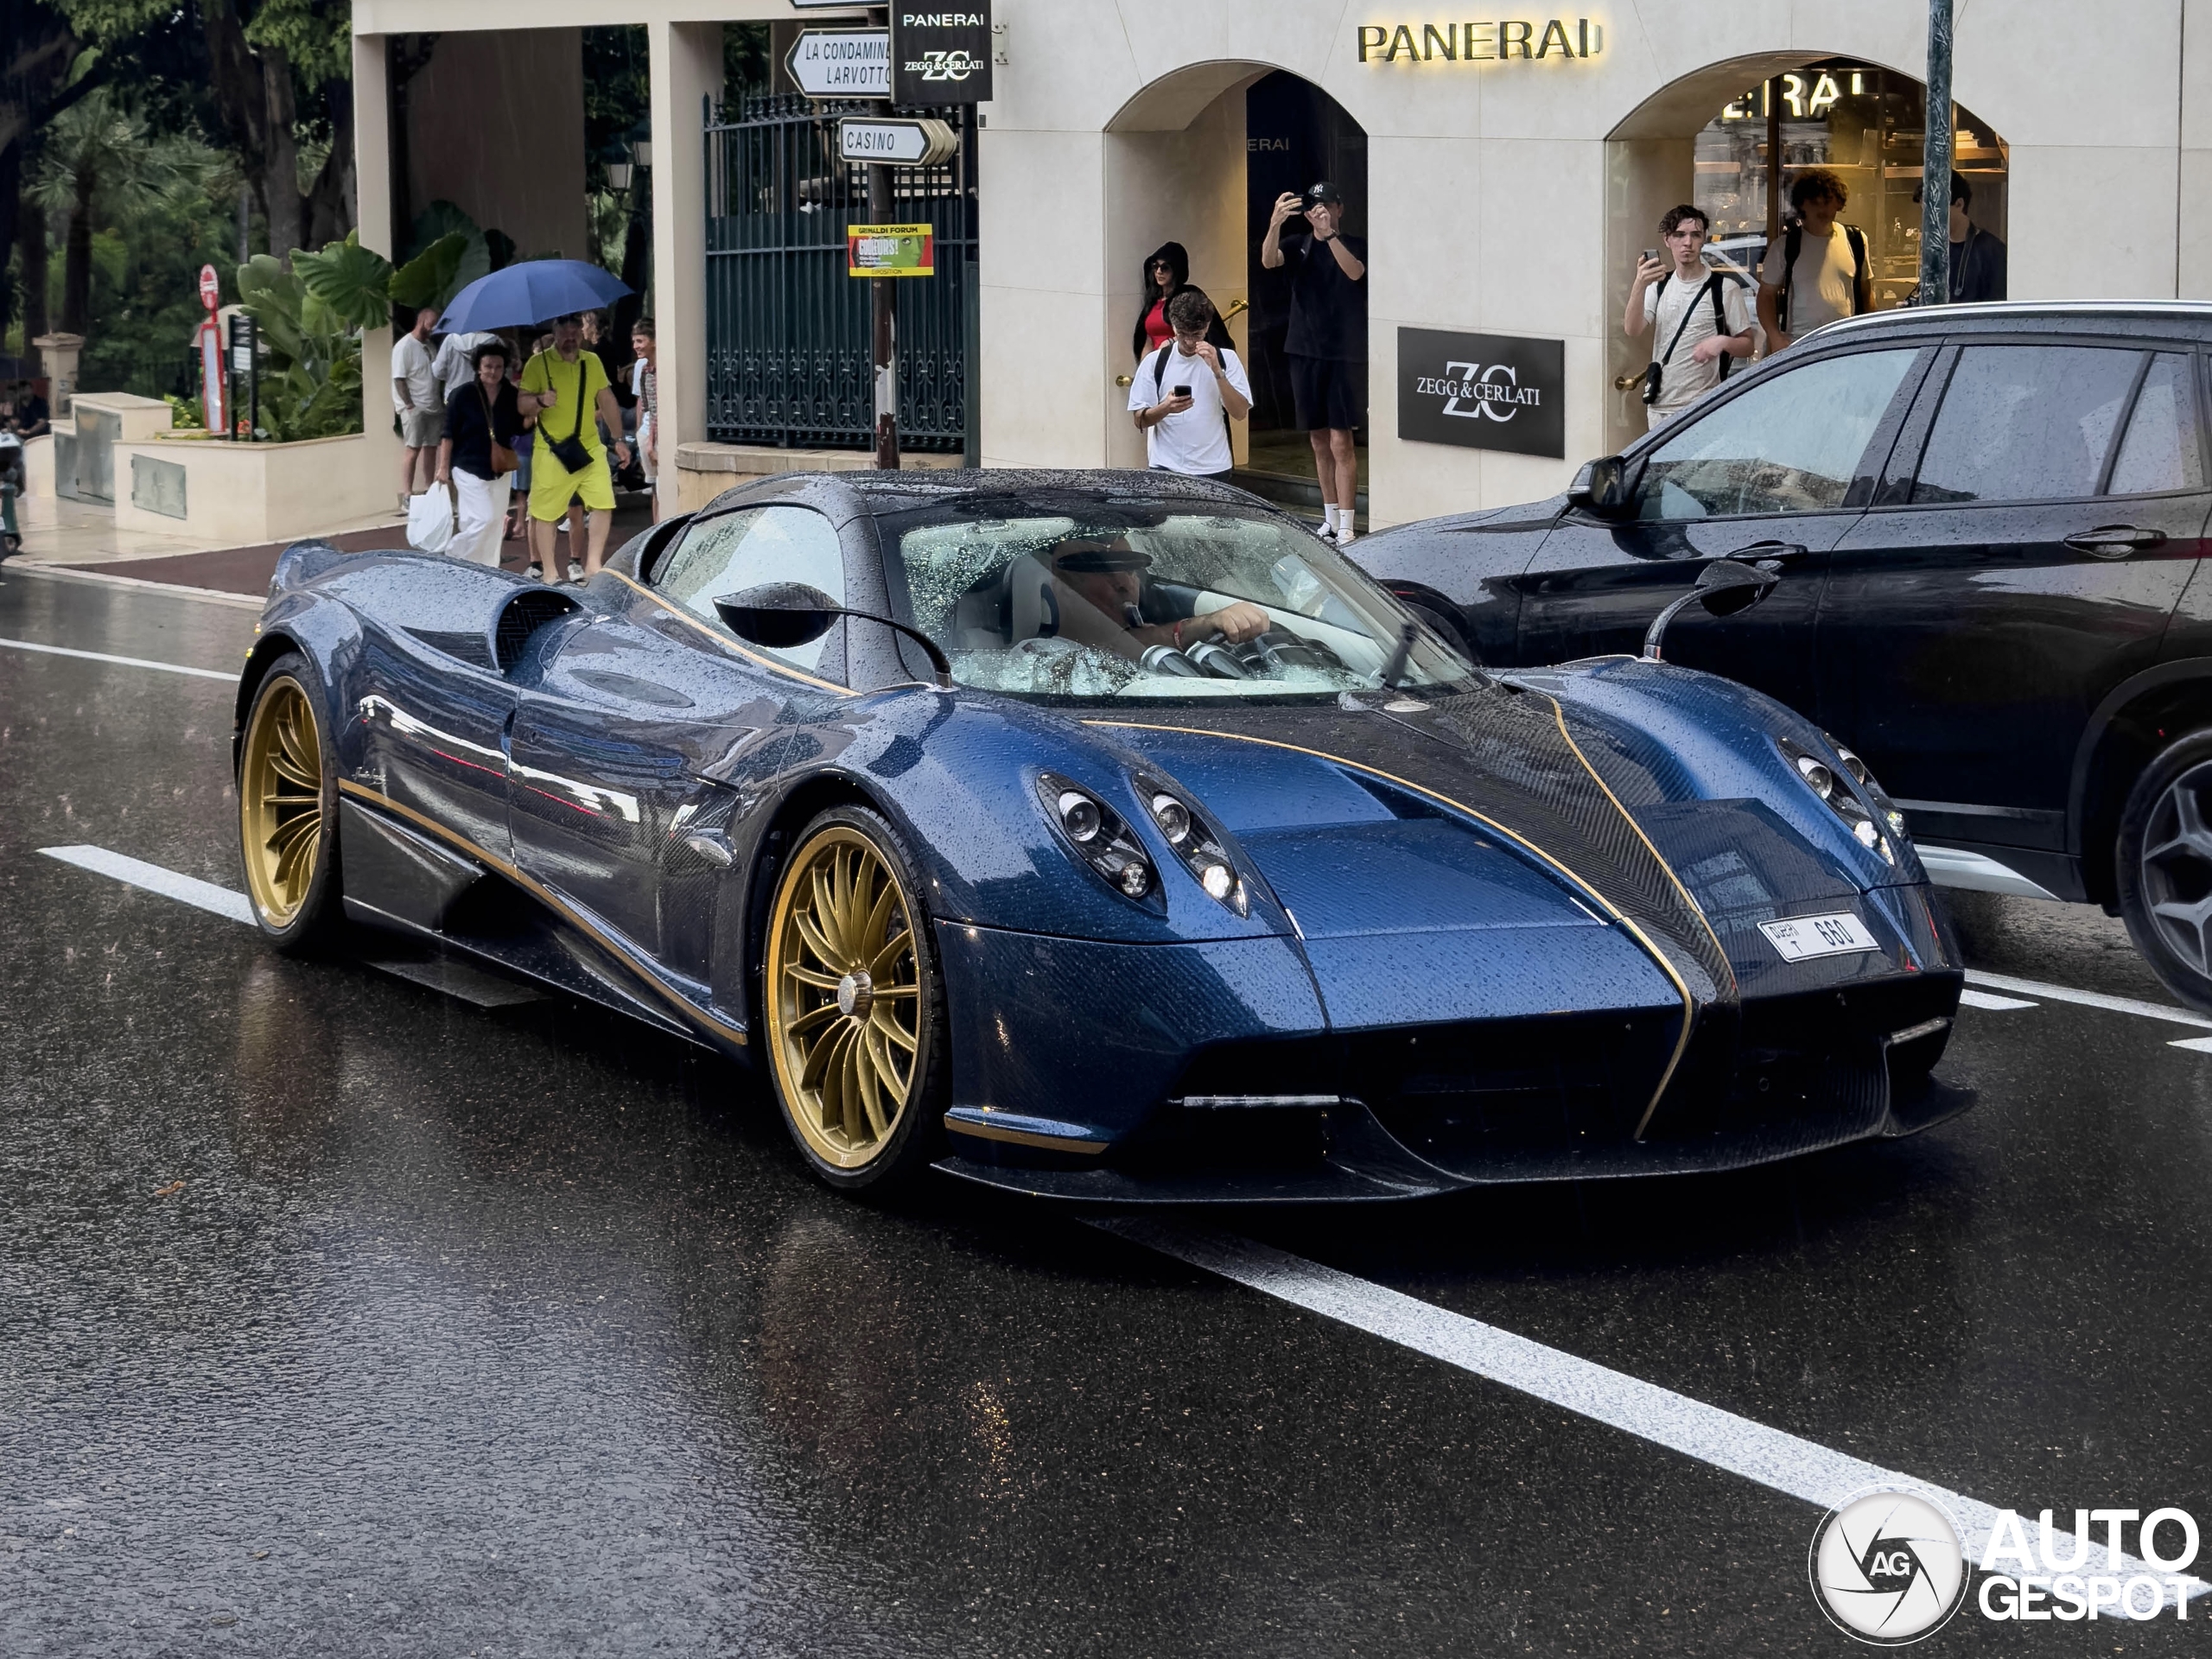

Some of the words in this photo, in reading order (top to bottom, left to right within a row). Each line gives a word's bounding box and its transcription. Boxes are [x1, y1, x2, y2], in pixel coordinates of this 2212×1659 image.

[903, 13, 984, 27] PANERAI
[1357, 18, 1589, 63] PANERAI
[805, 43, 819, 60] LA
[847, 131, 895, 150] CASINO
[1416, 377, 1459, 397] ZEGG
[1473, 383, 1541, 406] CERLATI
[1815, 918, 1854, 946] 660
[1790, 940, 1803, 954] T
